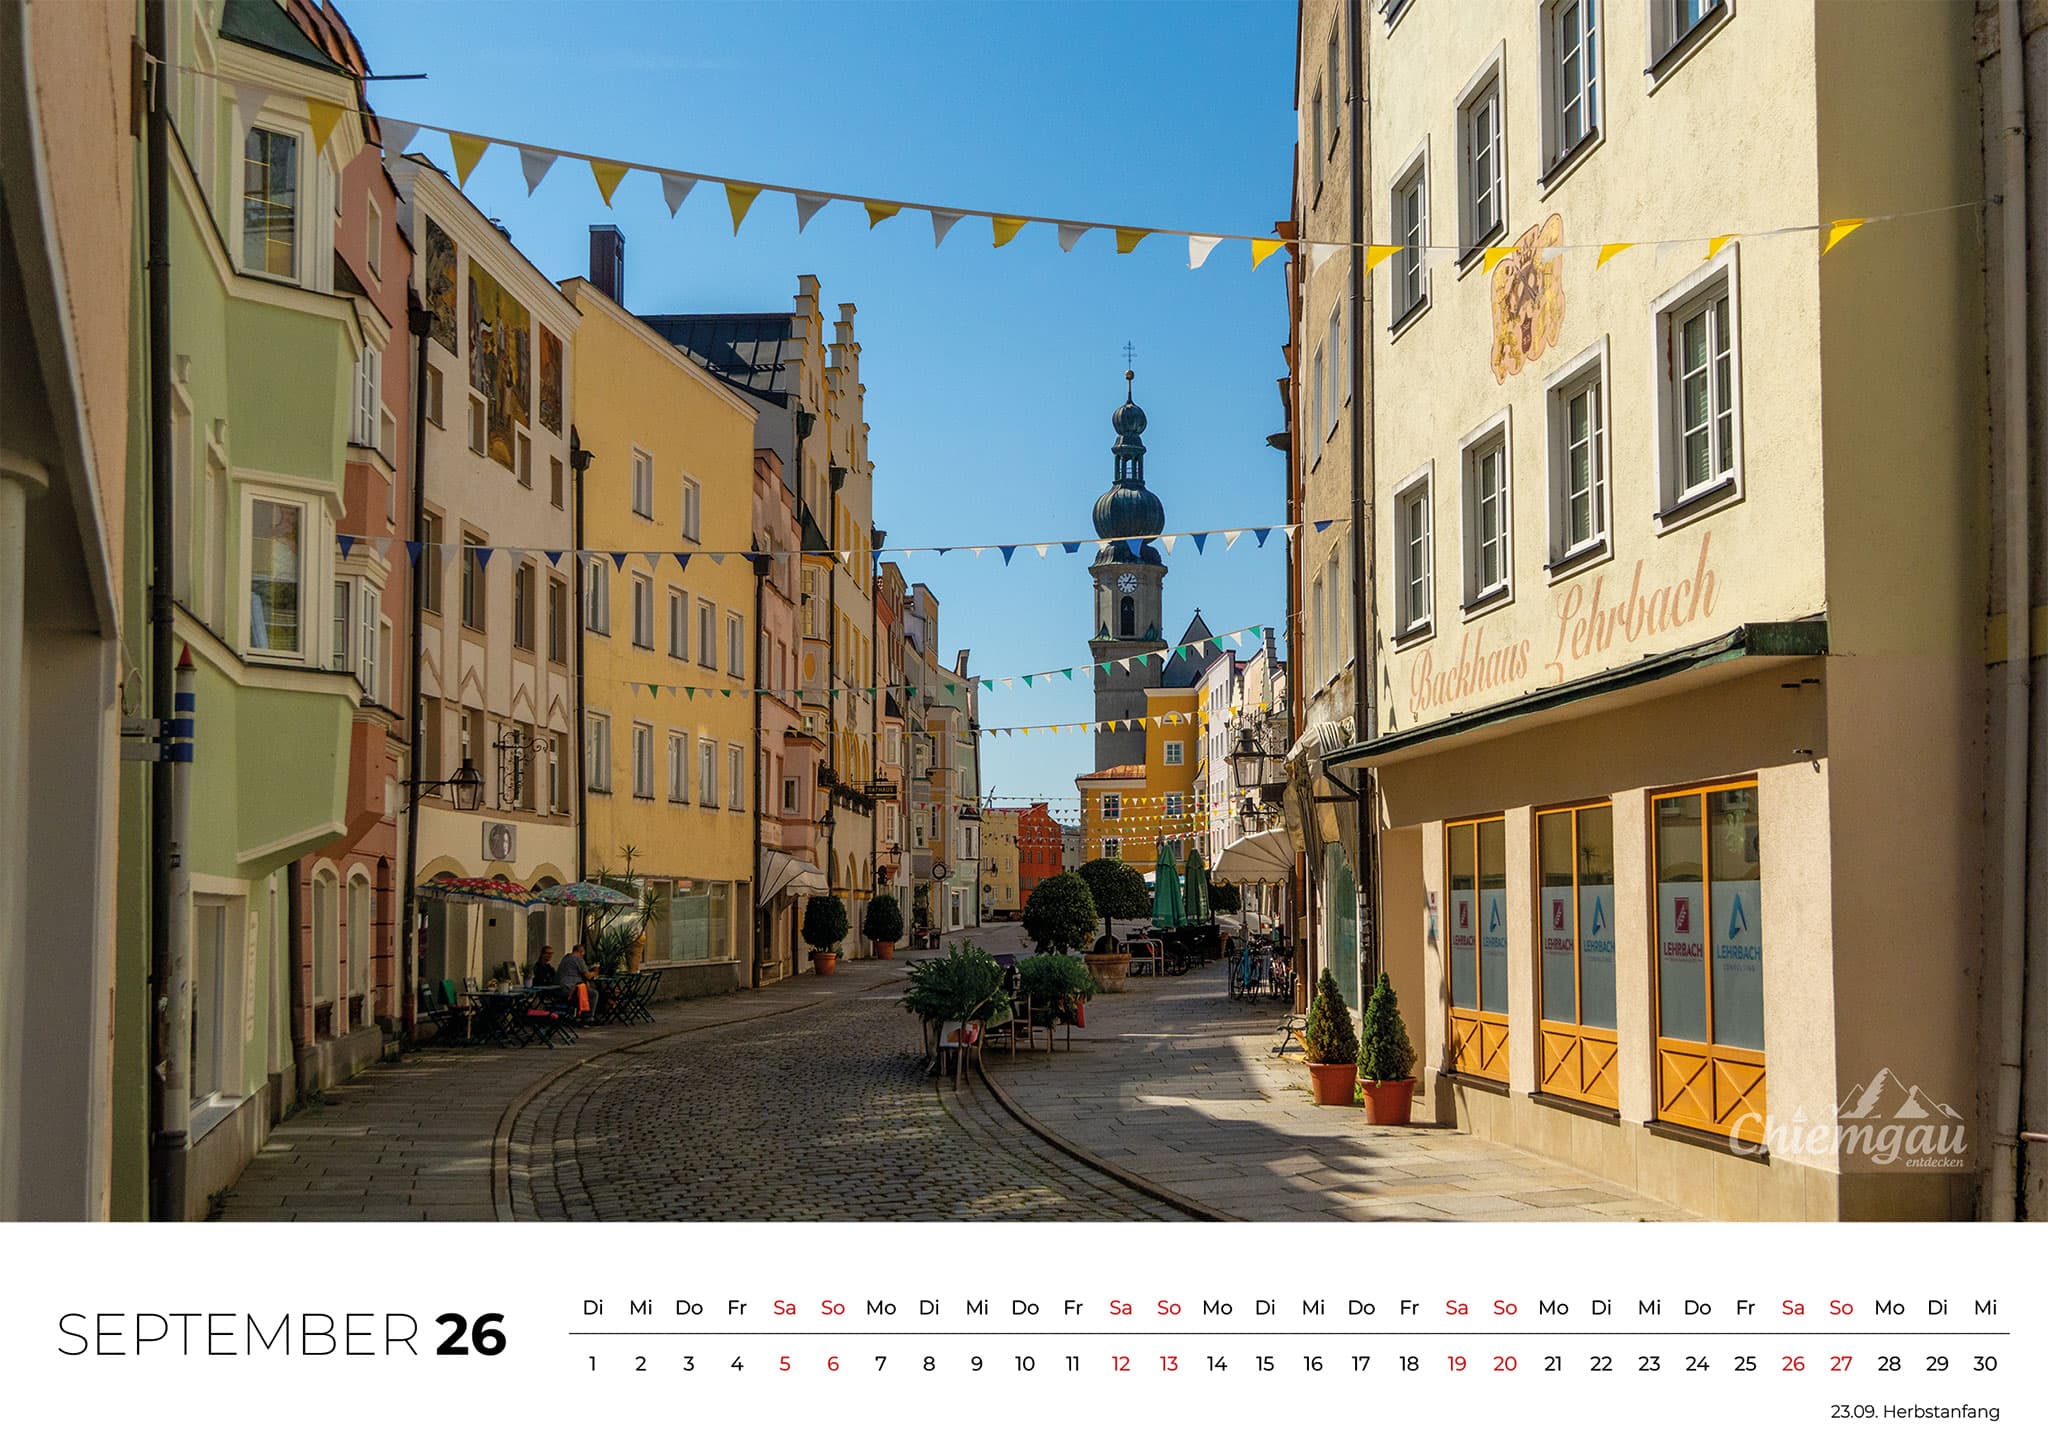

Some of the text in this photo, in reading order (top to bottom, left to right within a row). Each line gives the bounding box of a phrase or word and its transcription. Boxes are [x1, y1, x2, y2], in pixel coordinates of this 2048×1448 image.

[1409, 530, 1721, 713] Backhaus Lehrbach
[1452, 935, 1476, 947] LEHRBACH
[1544, 938, 1574, 951] LEHRBACH
[1583, 939, 1616, 953] LEHRBACH
[1663, 942, 1703, 958] LEHRBACH
[1716, 944, 1761, 961] LEHRBACH
